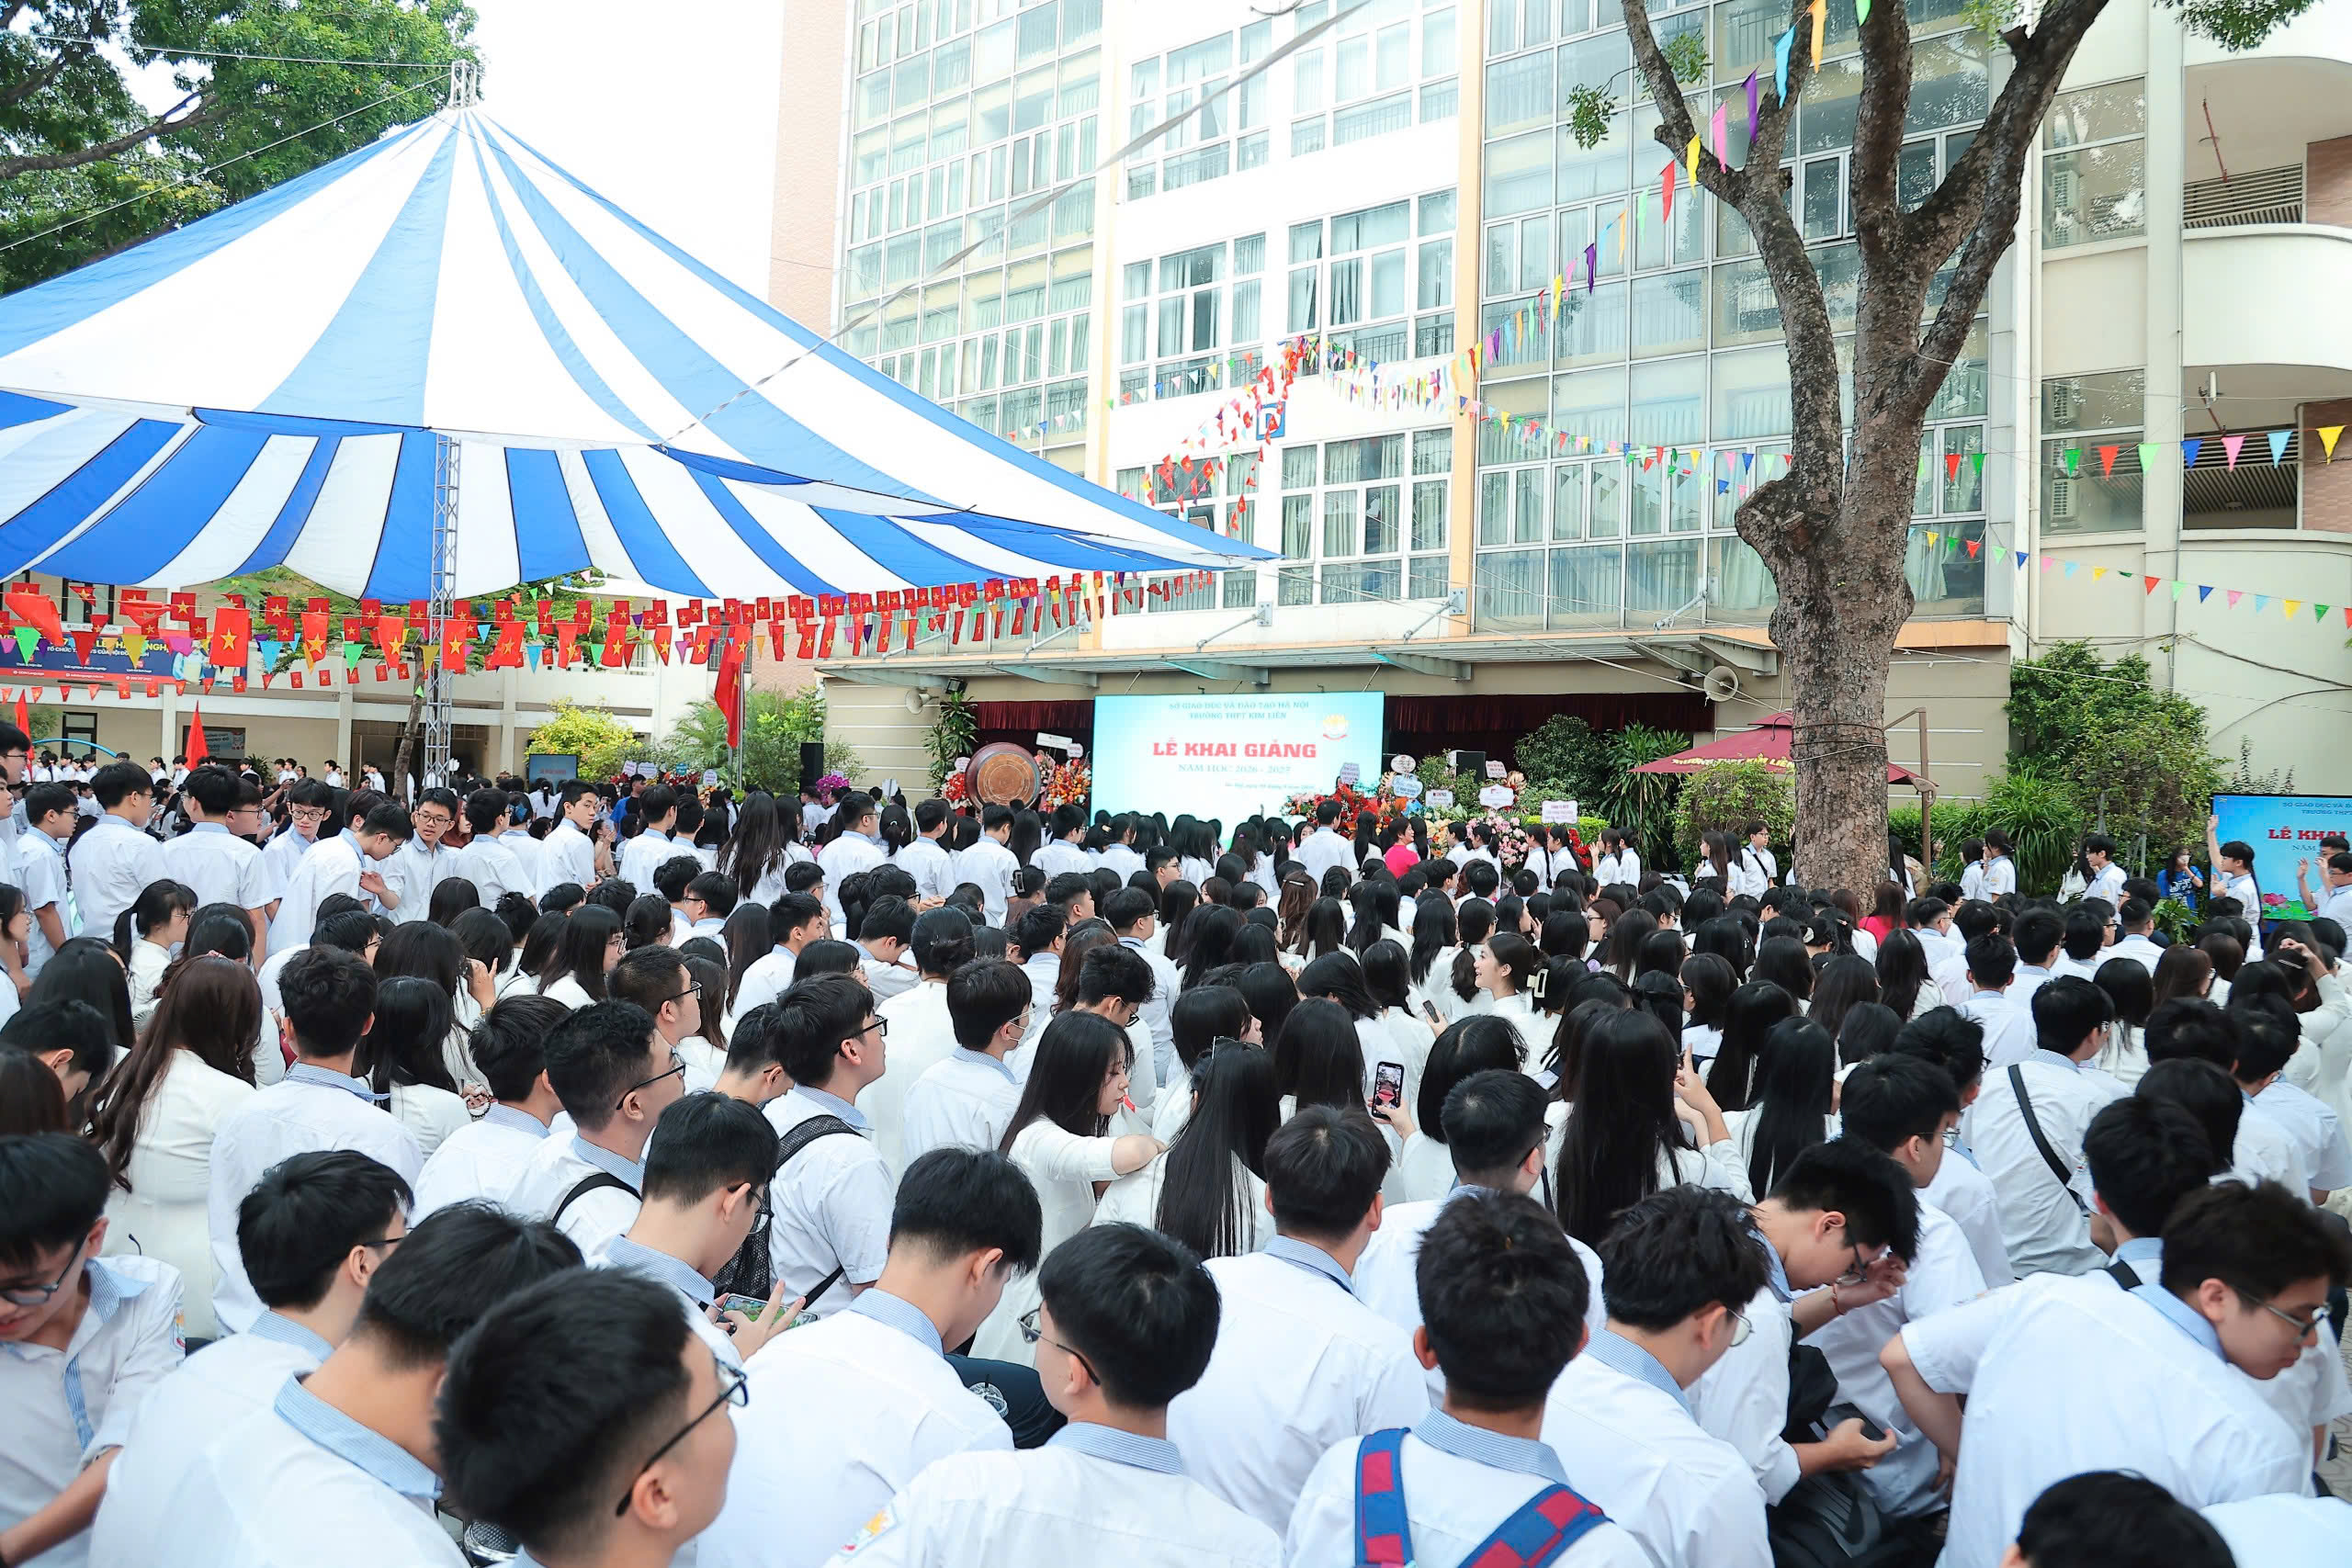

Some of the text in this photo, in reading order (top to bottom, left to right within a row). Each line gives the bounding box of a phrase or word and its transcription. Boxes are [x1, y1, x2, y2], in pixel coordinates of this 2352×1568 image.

[1259, 407, 1282, 435] D
[1267, 711, 1287, 719] LIÊN
[1153, 736, 1317, 758] LỄ KHAI GIẢNG
[2268, 826, 2292, 840] LỄ
